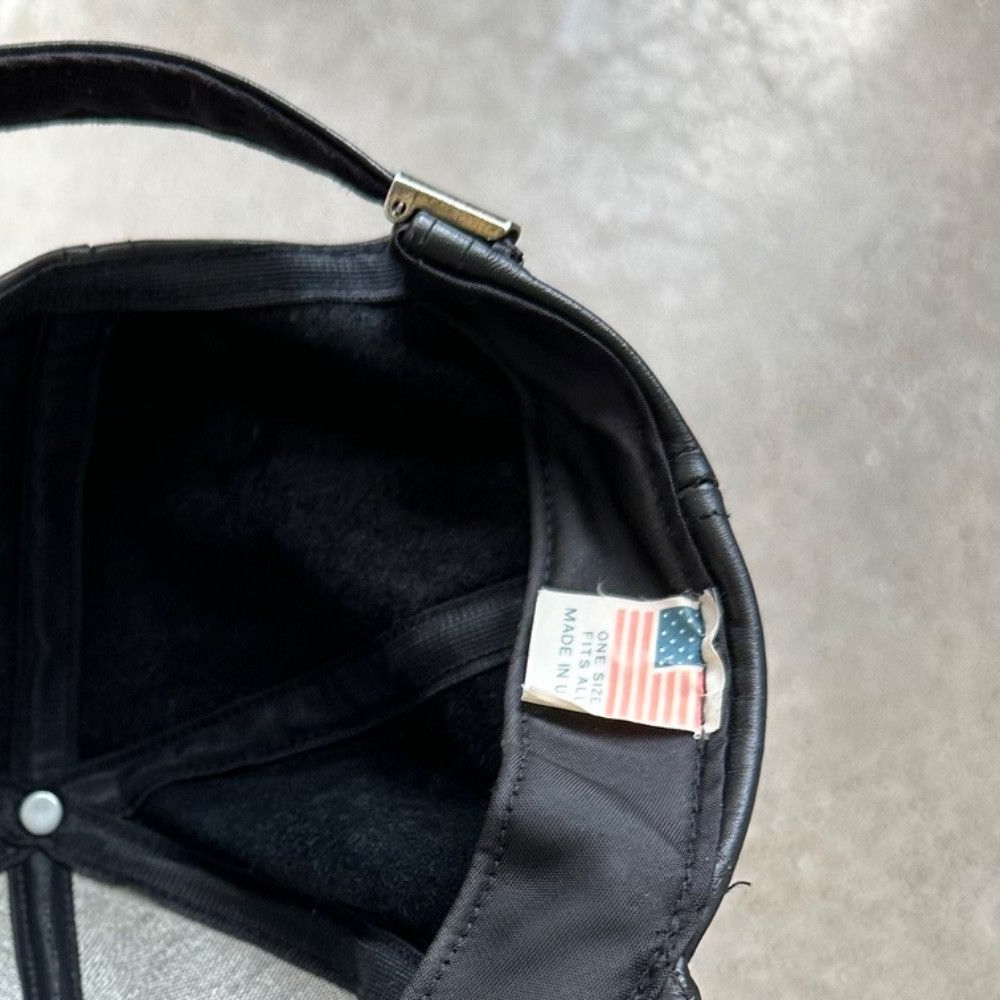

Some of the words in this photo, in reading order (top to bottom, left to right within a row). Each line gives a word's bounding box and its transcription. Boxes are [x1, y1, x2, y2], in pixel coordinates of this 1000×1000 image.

[558, 608, 577, 656] MADE
[594, 630, 609, 665] ONE
[579, 631, 594, 669] FITS
[556, 664, 570, 679] IN
[574, 676, 588, 701] ALL
[590, 672, 605, 705] SIZE
